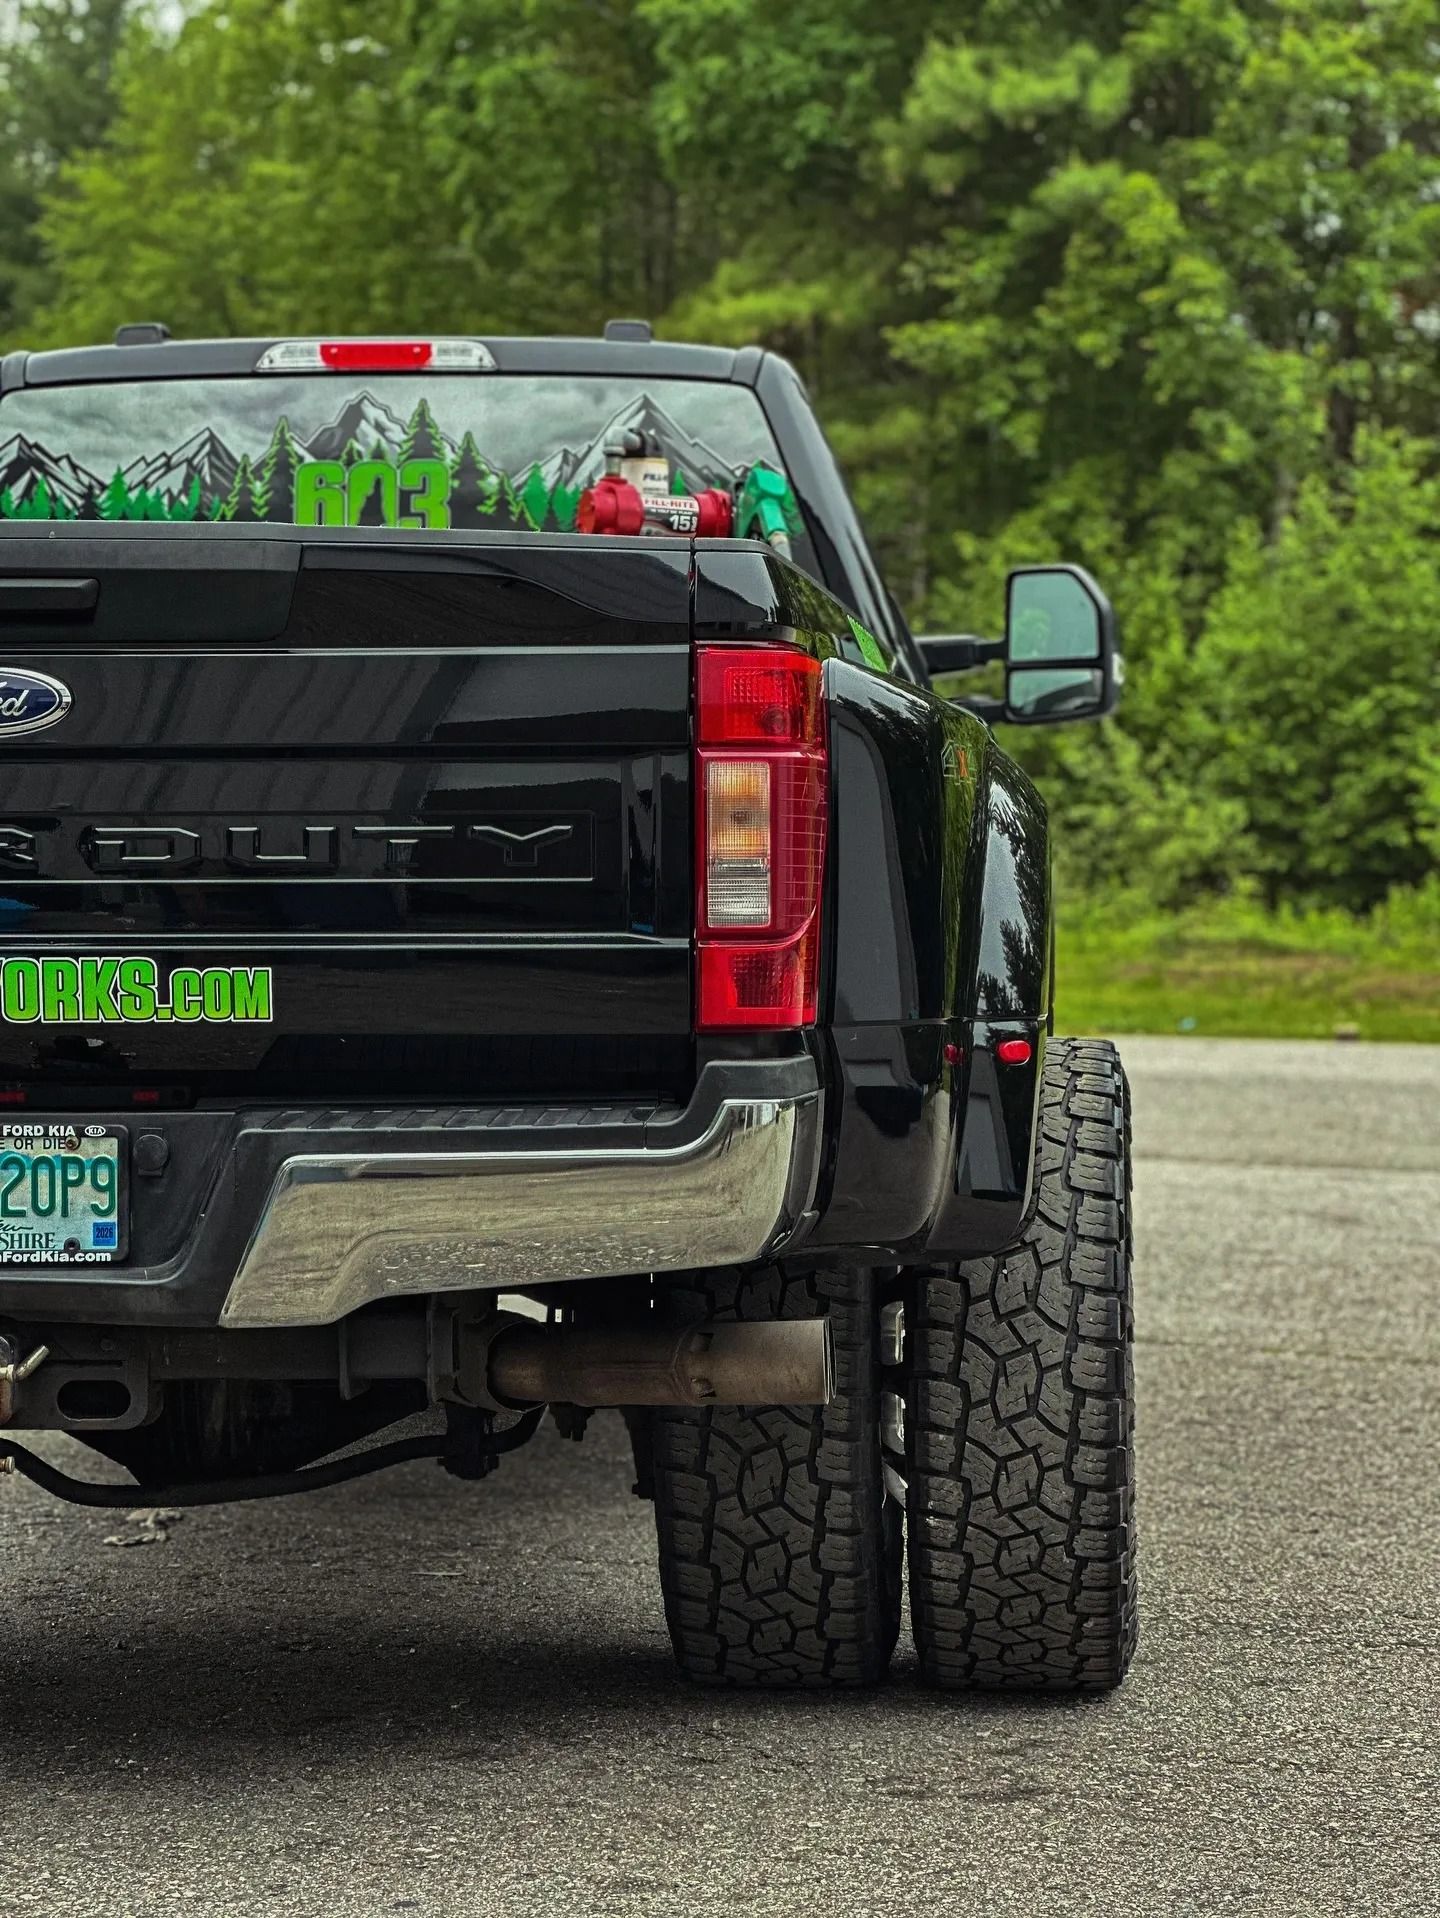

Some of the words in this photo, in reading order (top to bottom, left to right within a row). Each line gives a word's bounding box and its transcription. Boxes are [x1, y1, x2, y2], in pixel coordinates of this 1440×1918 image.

[295, 458, 451, 529] 603
[670, 515, 690, 531] 15
[84, 824, 574, 871] DUTY
[2, 1125, 44, 1137] FORD
[48, 1126, 76, 1137] KIA
[13, 1138, 34, 1150] OR
[42, 1138, 66, 1150] DIE
[0, 1251, 111, 1262] FordKia.com
